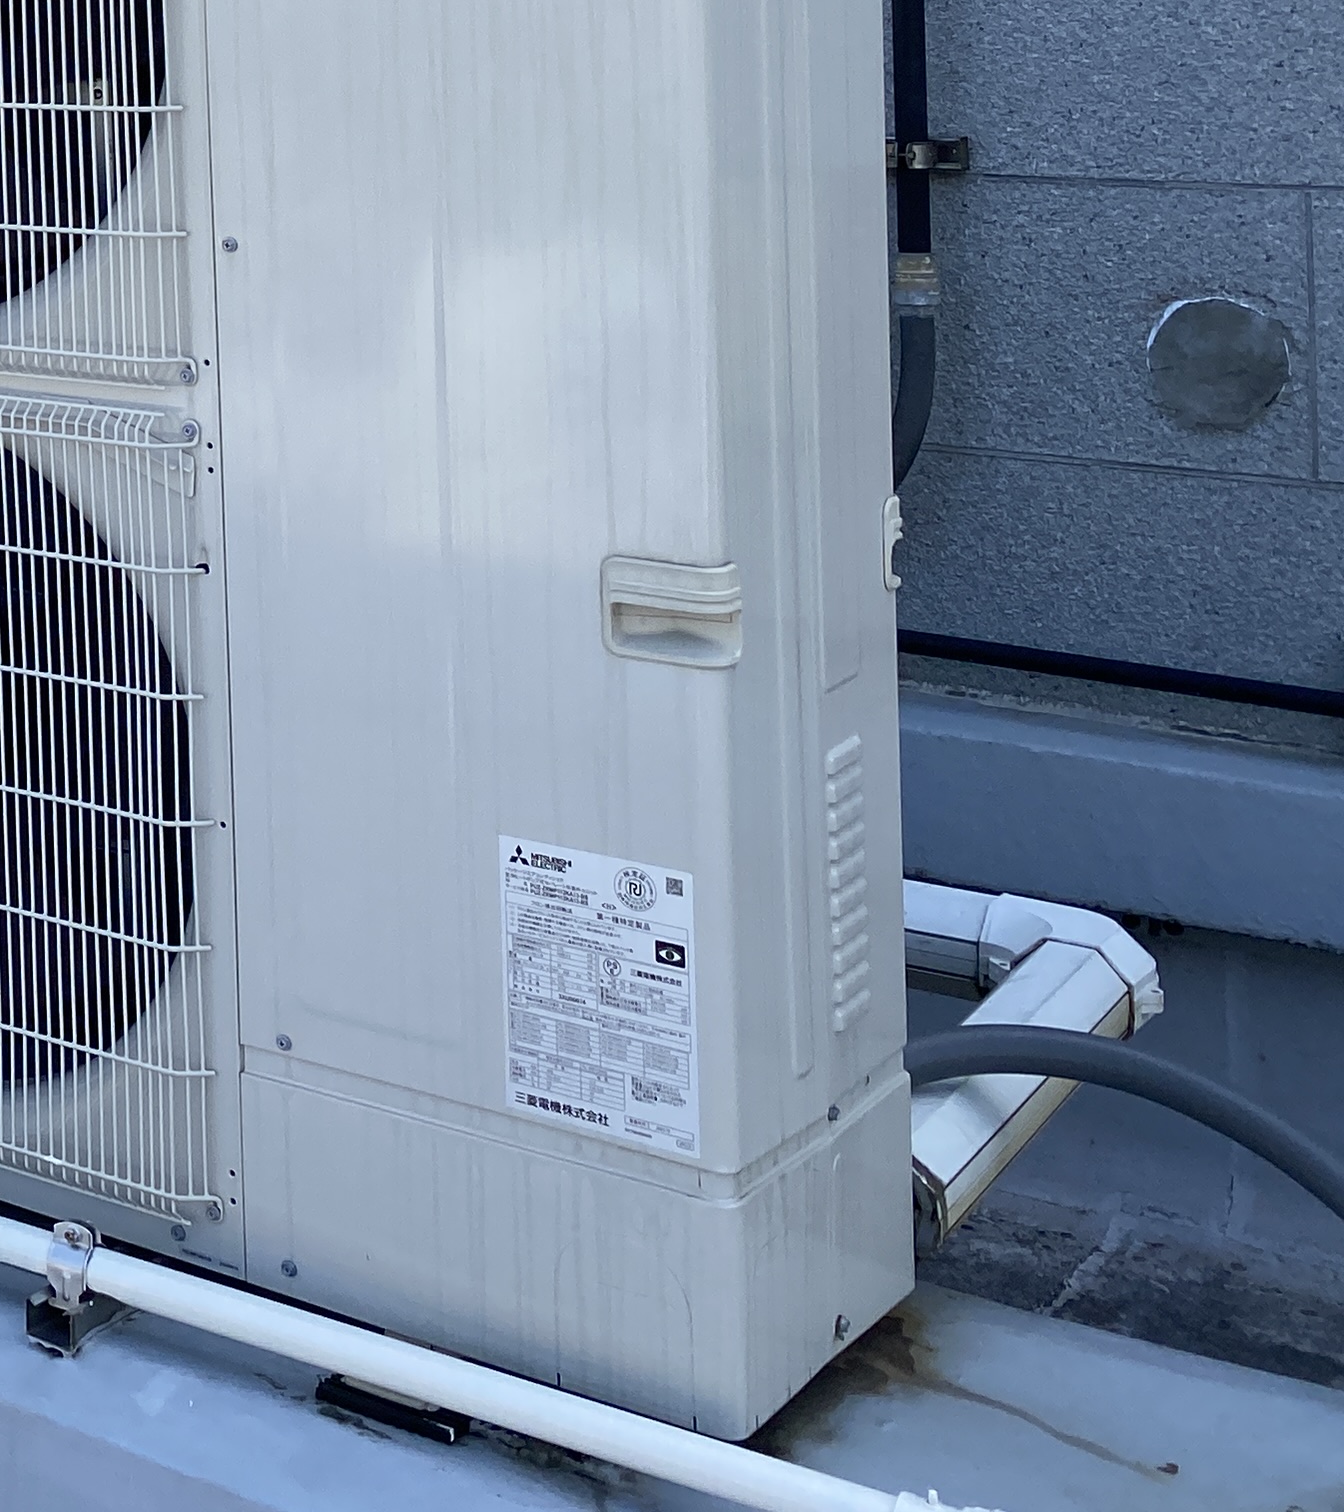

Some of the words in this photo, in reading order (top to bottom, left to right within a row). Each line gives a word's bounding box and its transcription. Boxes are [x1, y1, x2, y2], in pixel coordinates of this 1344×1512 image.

[531, 859, 567, 874] ELECTRIC
[514, 1090, 610, 1128] 三菱電機株式会社
